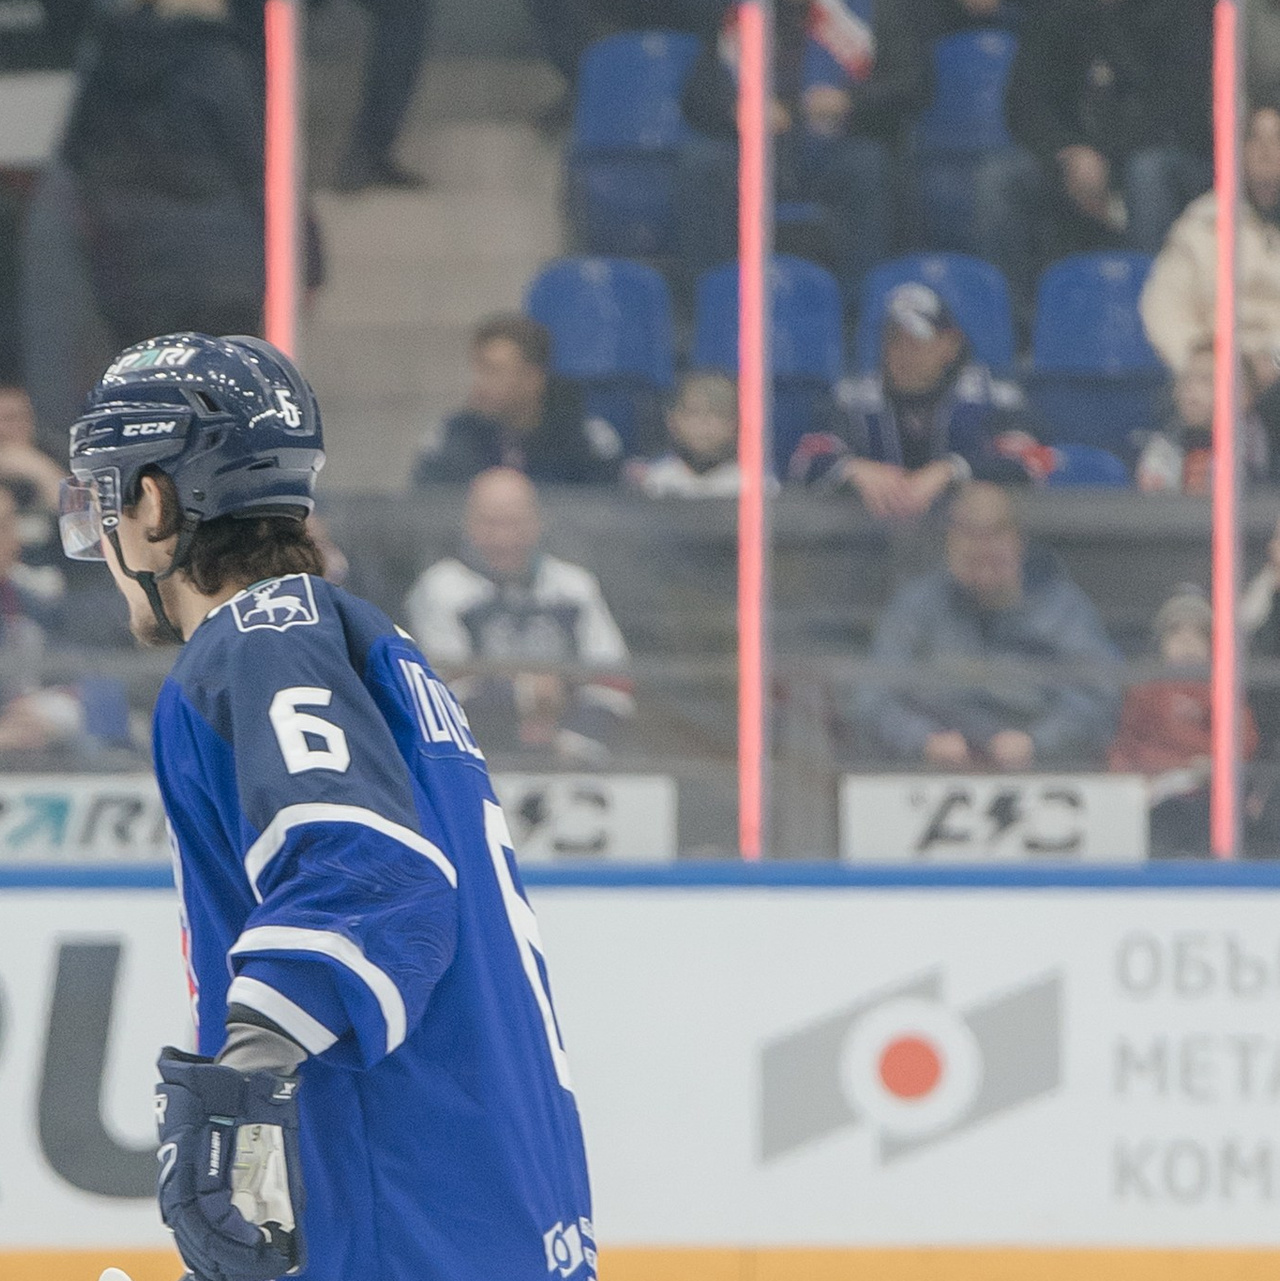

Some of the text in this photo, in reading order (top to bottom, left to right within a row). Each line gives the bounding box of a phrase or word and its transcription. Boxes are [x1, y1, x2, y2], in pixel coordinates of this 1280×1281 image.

[115, 348, 196, 375] PARI
[122, 421, 176, 437] CCM
[268, 687, 351, 774] 6
[1113, 1032, 1280, 1101] МЕТ
